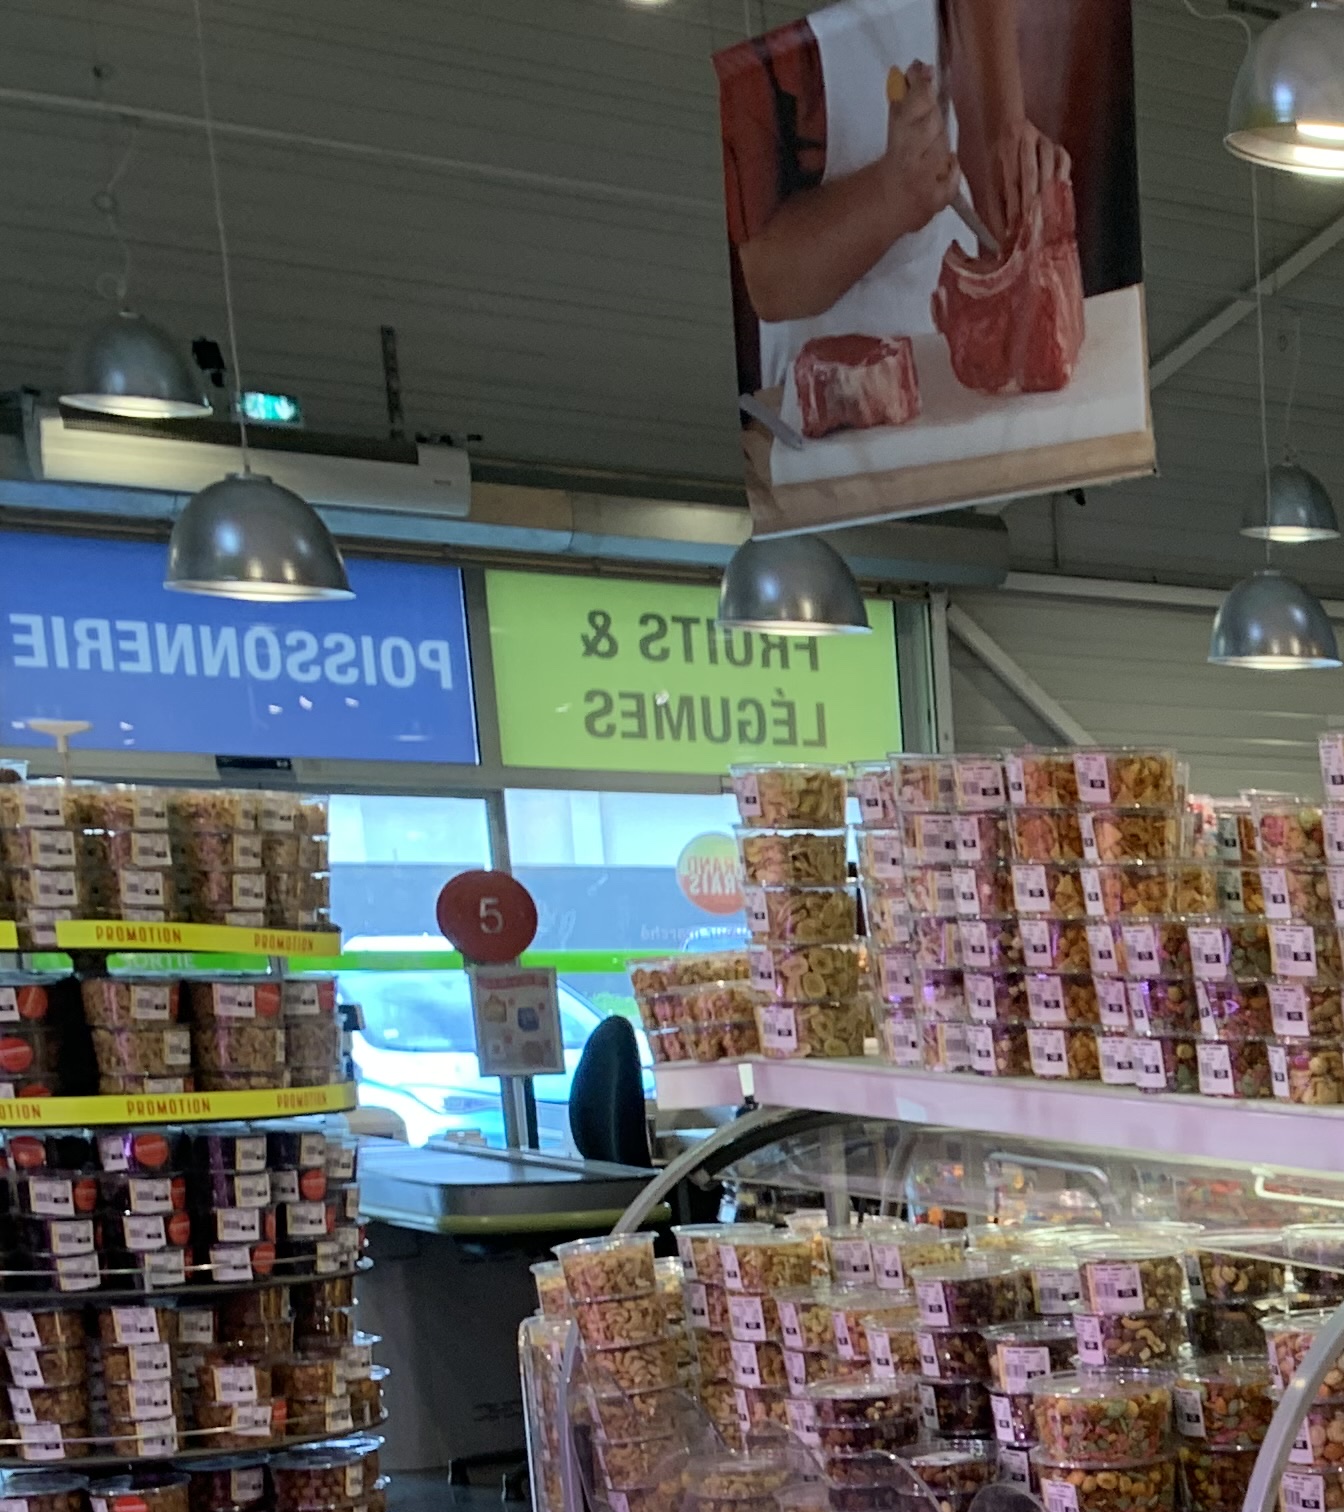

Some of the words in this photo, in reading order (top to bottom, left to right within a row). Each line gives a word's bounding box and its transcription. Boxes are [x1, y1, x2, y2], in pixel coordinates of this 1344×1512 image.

[479, 897, 504, 934] 5
[95, 925, 182, 944] PROMOTION
[253, 933, 314, 951] PROMOTION
[127, 1098, 211, 1117] PROMOTION
